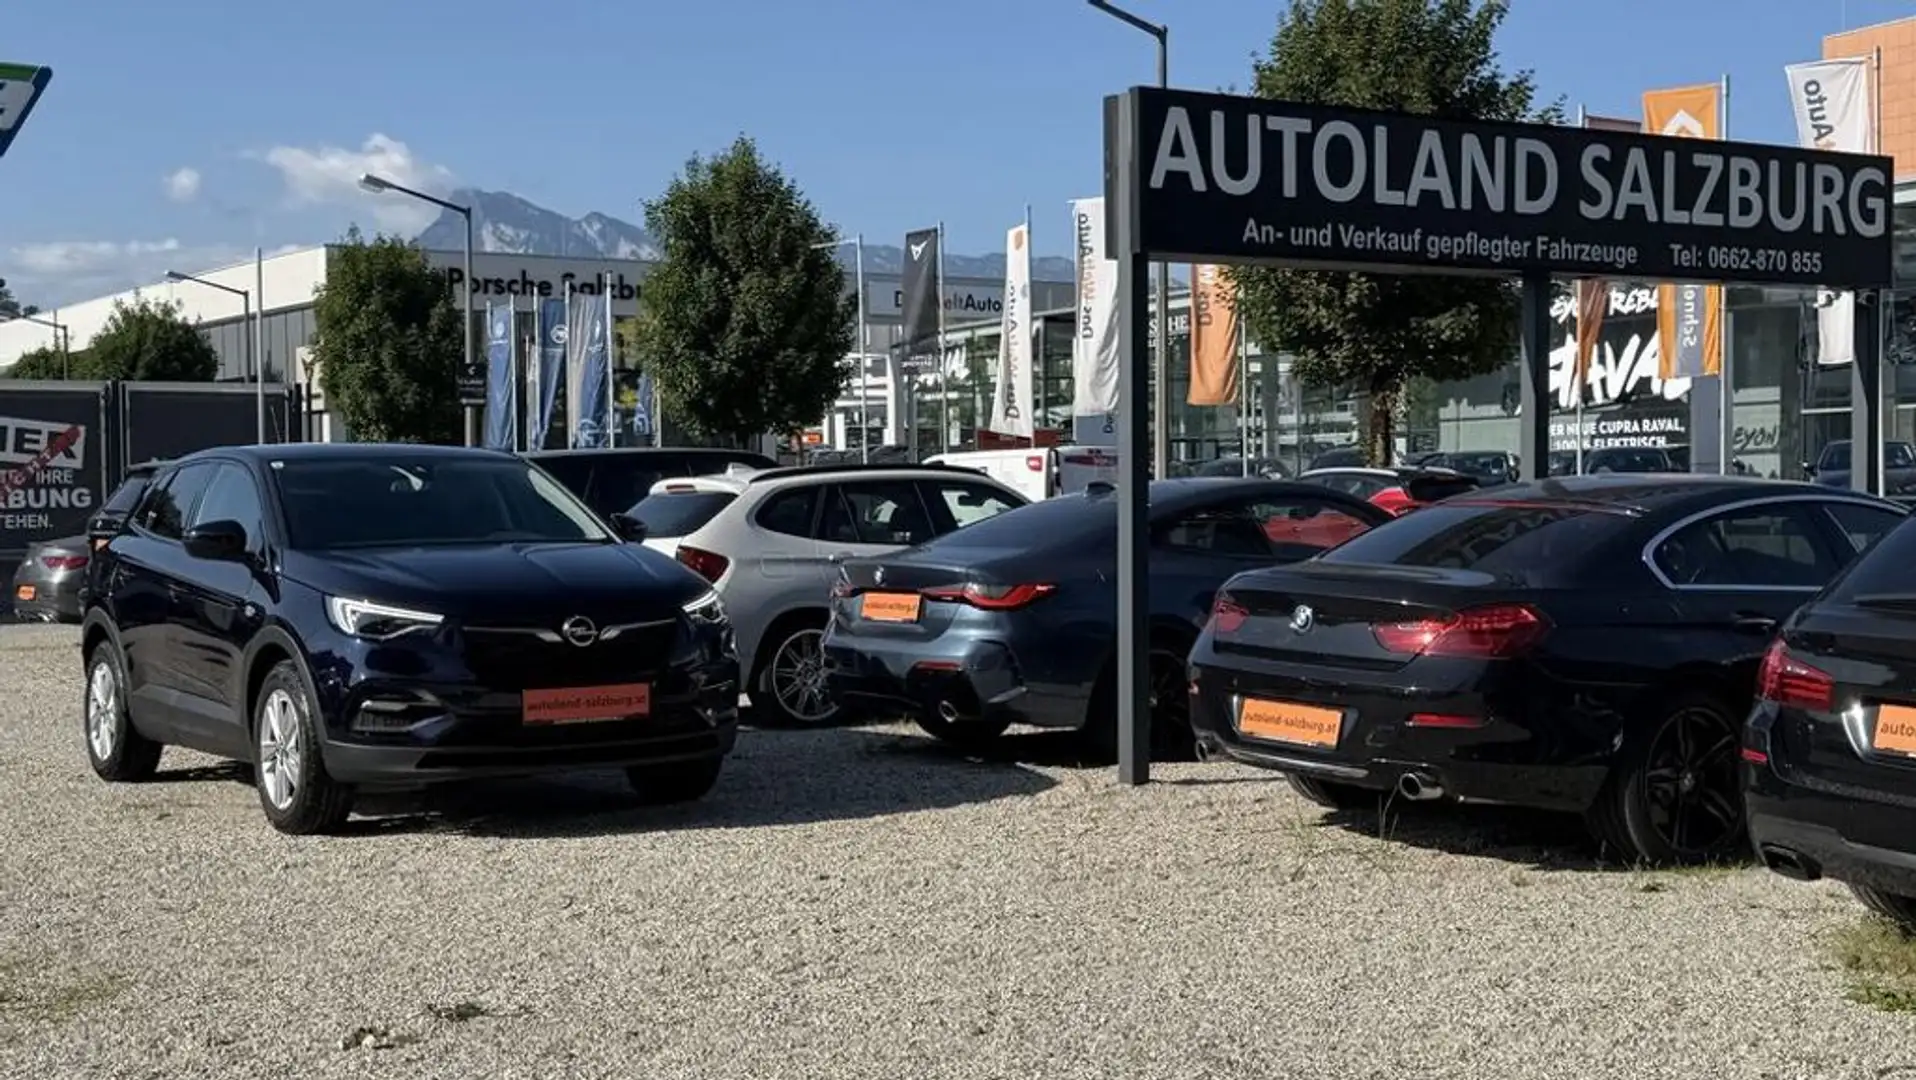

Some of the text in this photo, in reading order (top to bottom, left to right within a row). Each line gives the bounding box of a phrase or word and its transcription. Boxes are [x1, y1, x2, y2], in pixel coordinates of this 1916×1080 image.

[1150, 106, 1886, 237] AUTOLAND SALZBURG
[1242, 217, 1822, 273] An- und Verkauf gepflegter Fahrzeuge Tel: 0662-870 855
[449, 267, 641, 300] Porsche Salb
[1566, 422, 1597, 436] NUE
[1598, 420, 1641, 435] CUPRA
[35, 469, 74, 485] IHRE
[1244, 711, 1337, 735] autoland-salzburg.at
[1880, 722, 1916, 737] auto
